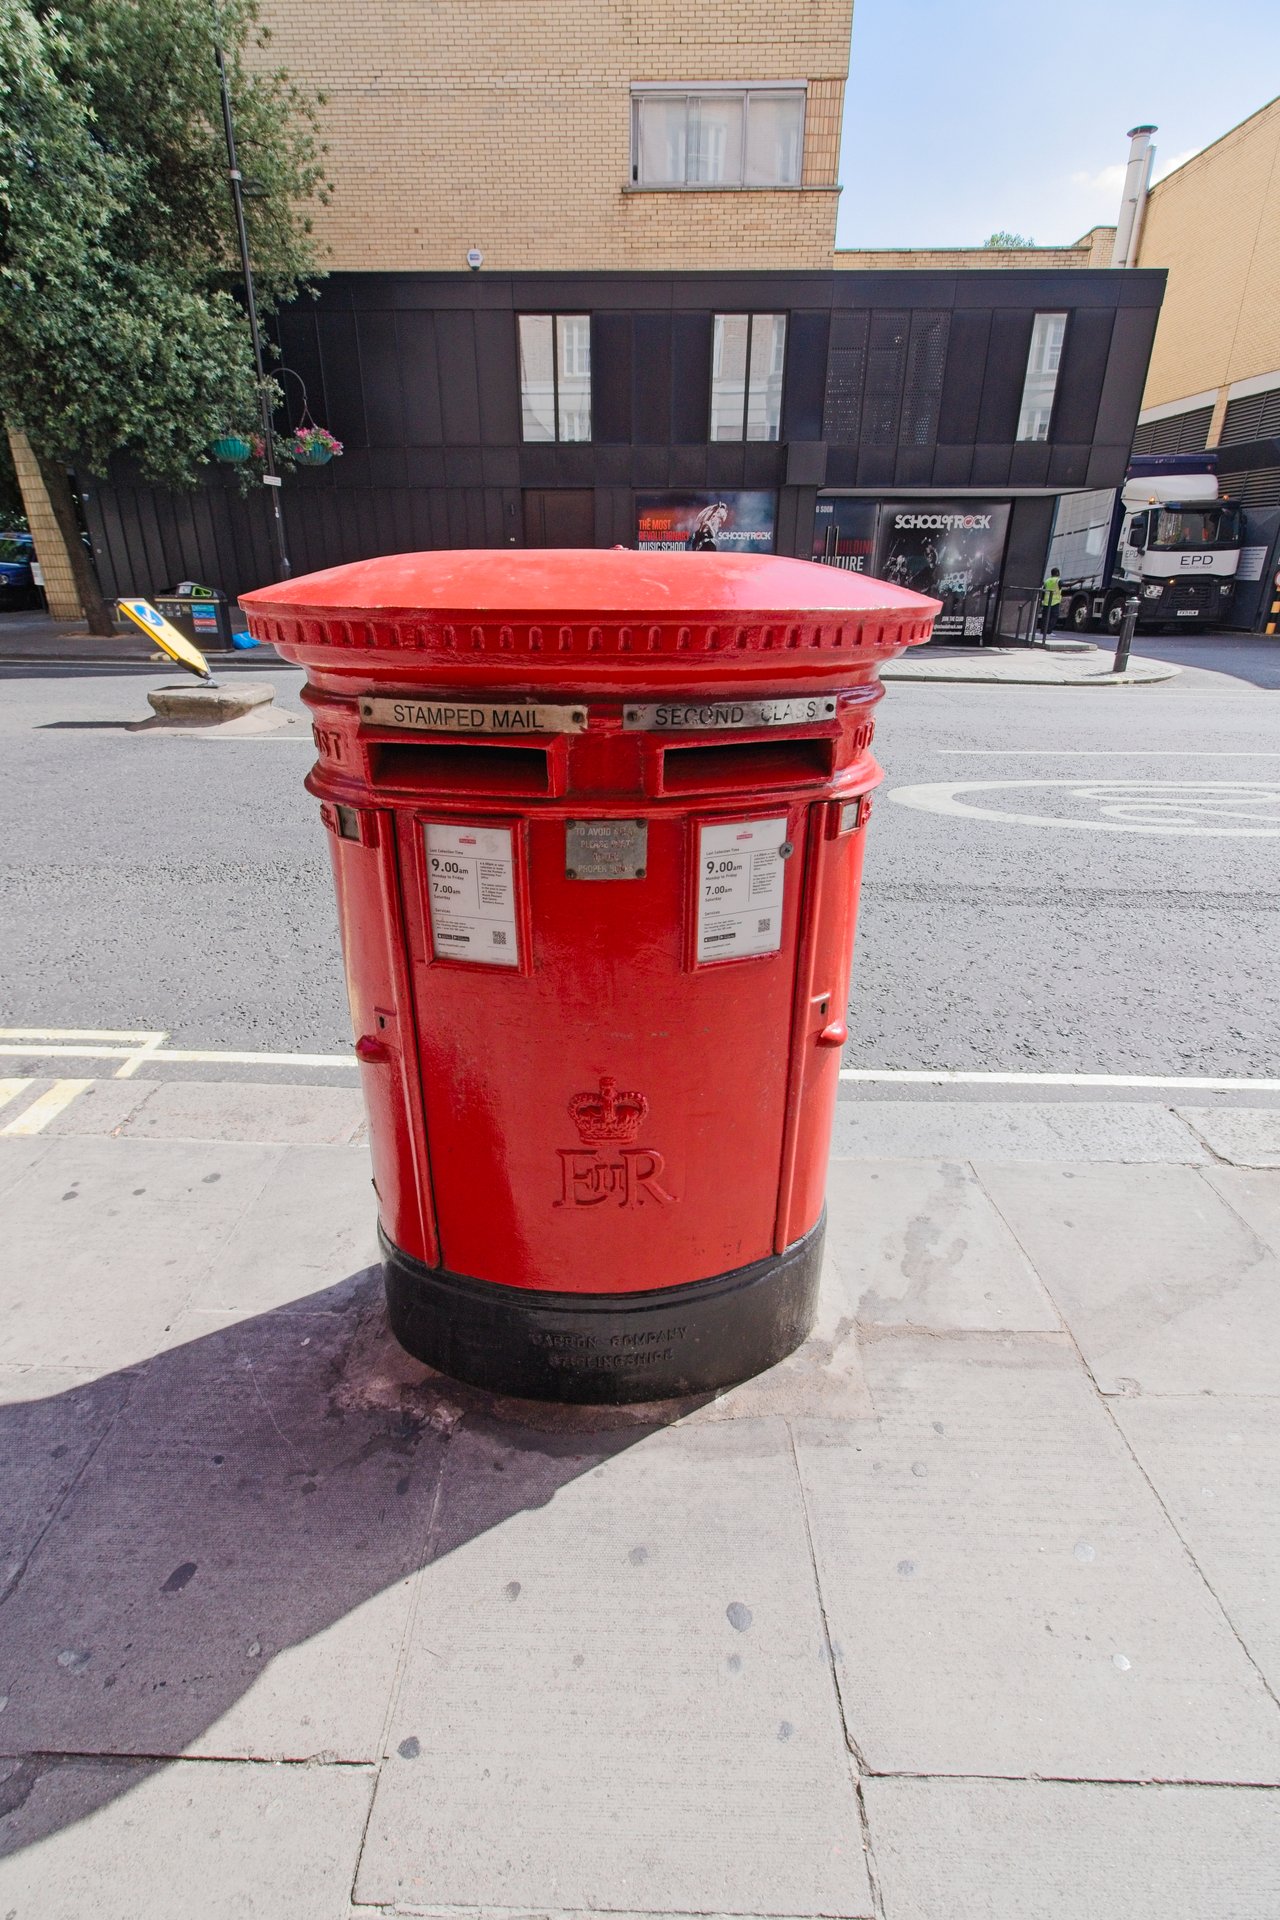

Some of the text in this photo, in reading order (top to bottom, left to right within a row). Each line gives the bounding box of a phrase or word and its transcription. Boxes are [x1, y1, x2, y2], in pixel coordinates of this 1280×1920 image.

[639, 519, 671, 530] THE MOST
[639, 531, 689, 541] REVOLUTIONARY
[639, 541, 661, 551] MUSIC
[1180, 555, 1213, 566] EPD
[394, 704, 545, 729] STAMPED MAIL
[655, 701, 816, 726] SECOND CLAS
[575, 828, 585, 836] TO
[587, 827, 611, 836] AVOID
[431, 858, 469, 874] 9.00am
[706, 860, 743, 874] 9.00am
[432, 882, 461, 894] 7.00am
[705, 885, 732, 895] 7.00am
[609, 1327, 687, 1348] COMPANY
